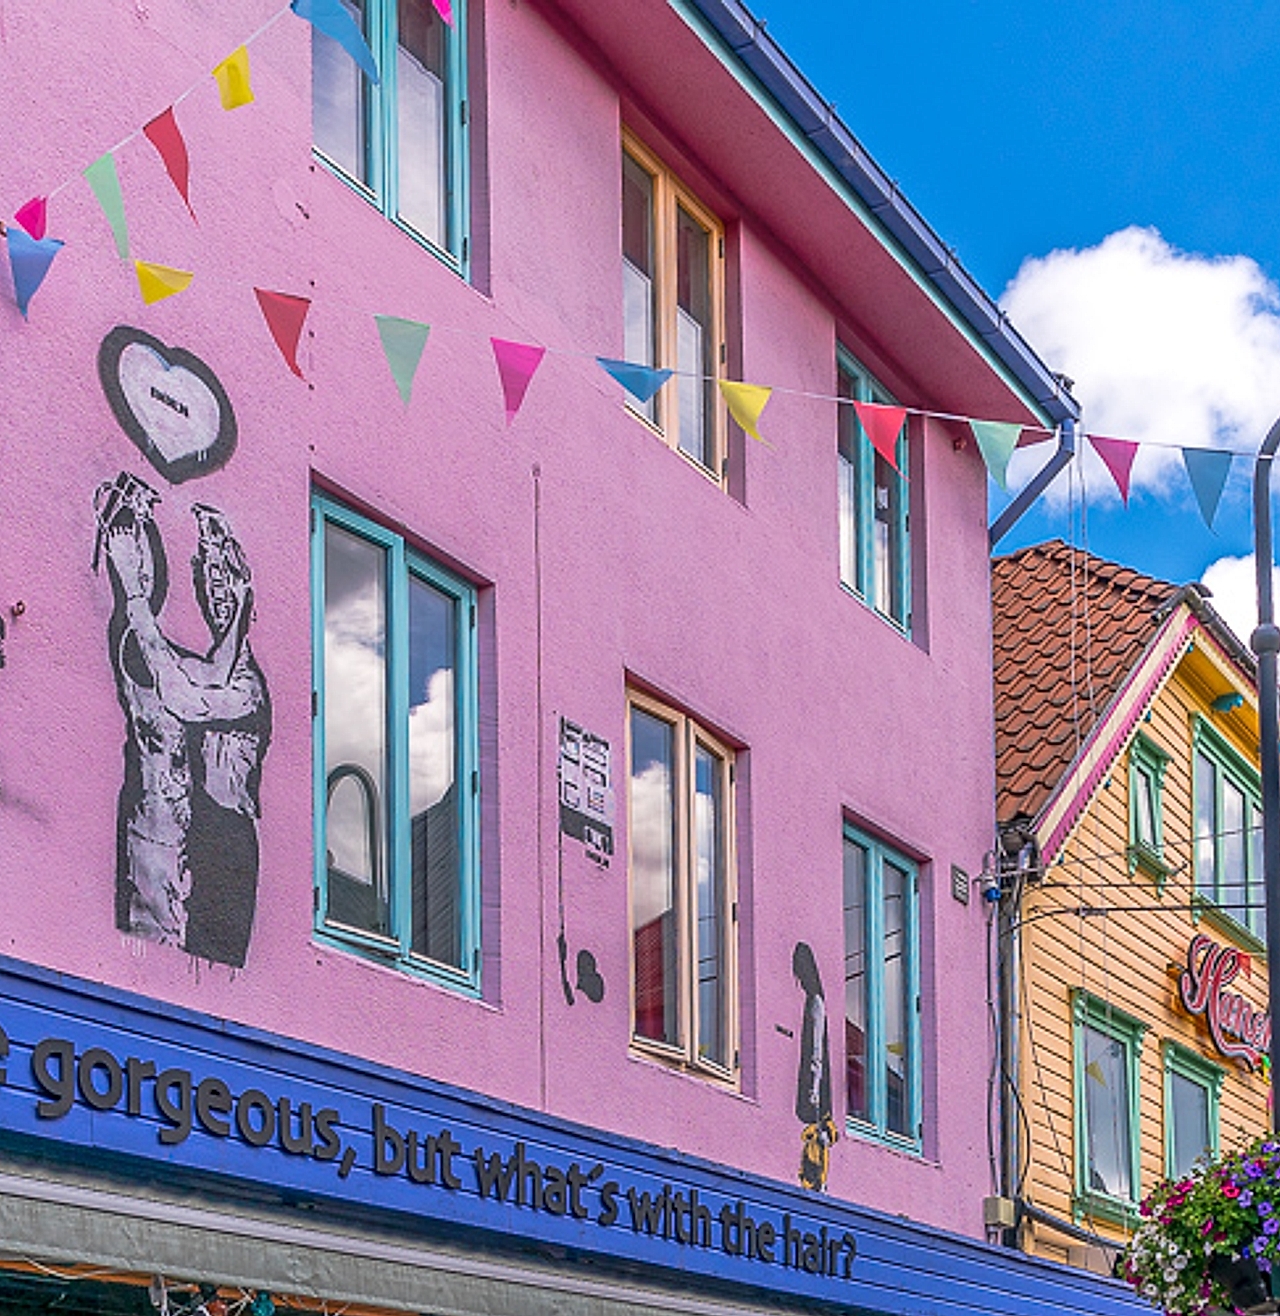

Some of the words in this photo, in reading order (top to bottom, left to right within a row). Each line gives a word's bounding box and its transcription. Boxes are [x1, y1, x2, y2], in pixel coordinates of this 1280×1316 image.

[31, 1036, 358, 1178] gorgeous,
[371, 1104, 462, 1190] but
[475, 1142, 620, 1226] what's
[629, 1182, 712, 1249] with
[721, 1204, 776, 1263] the
[783, 1212, 856, 1280] hair?
